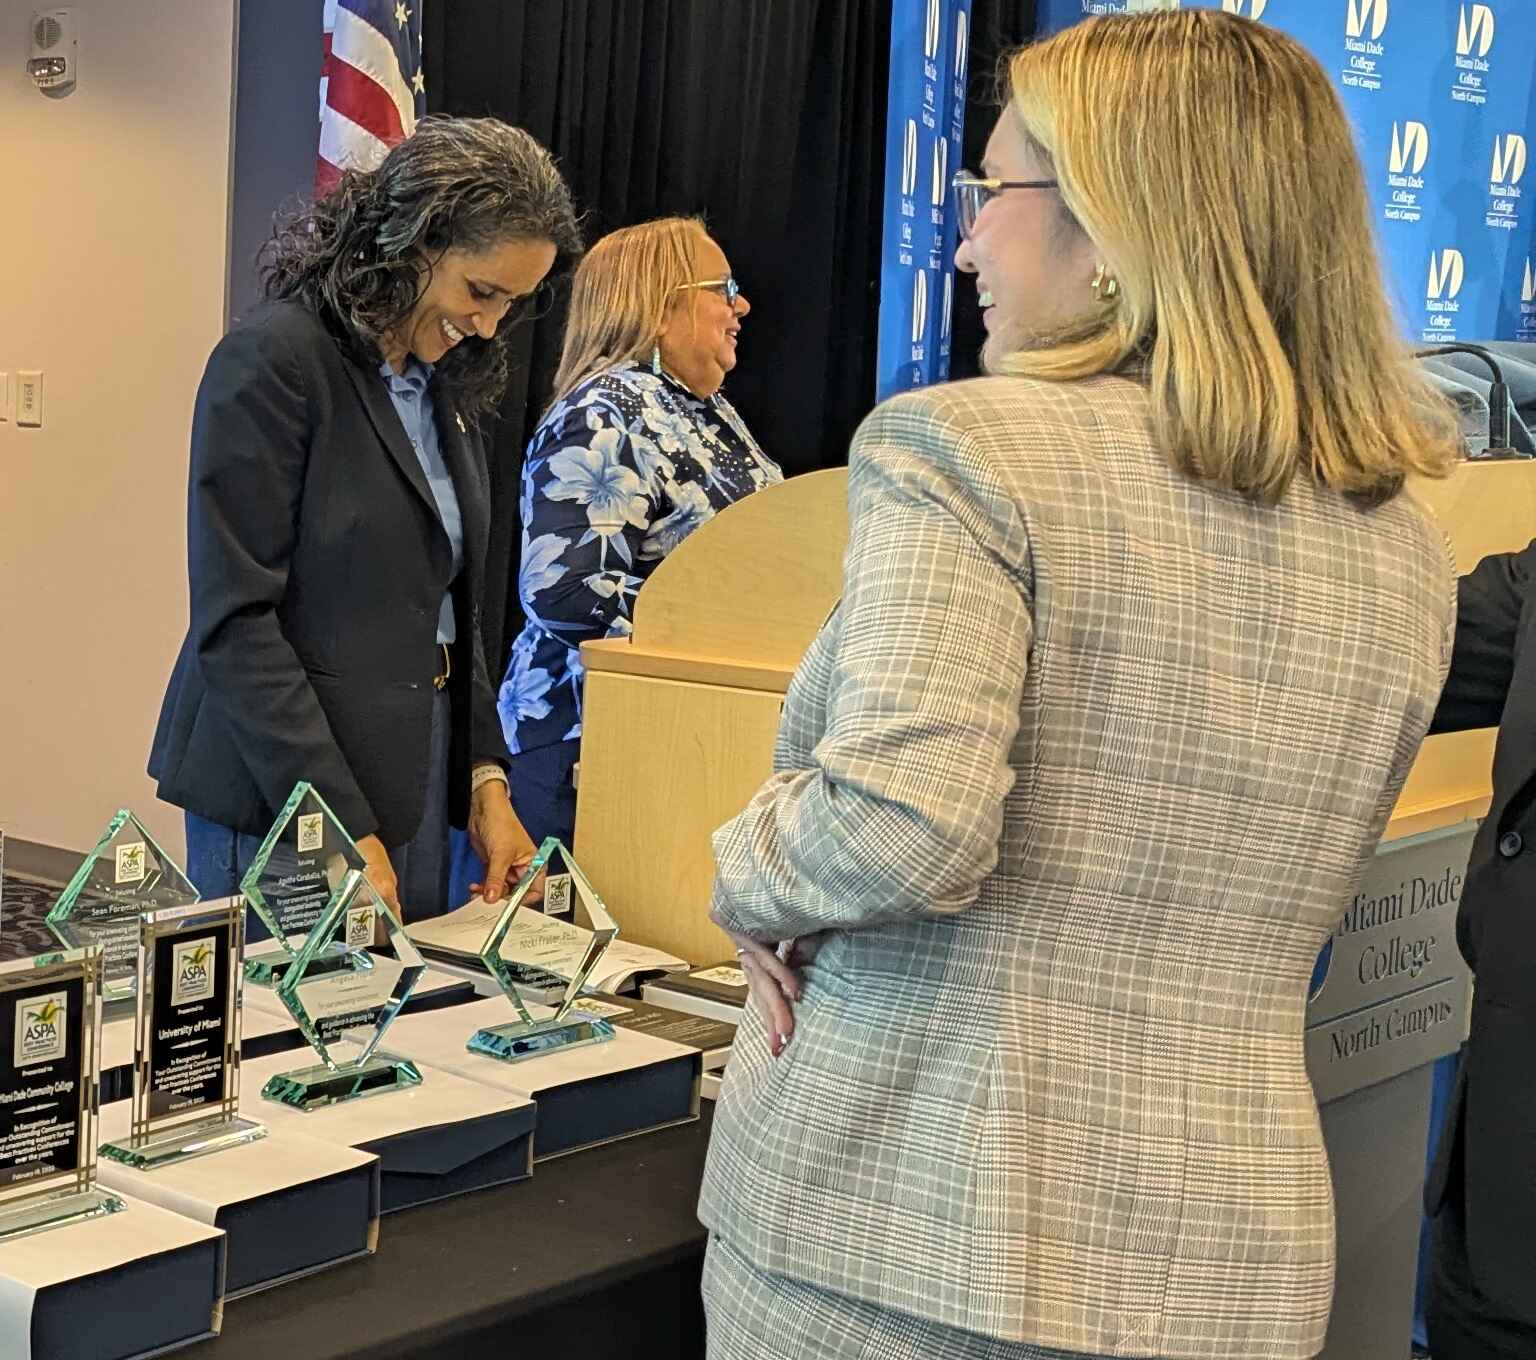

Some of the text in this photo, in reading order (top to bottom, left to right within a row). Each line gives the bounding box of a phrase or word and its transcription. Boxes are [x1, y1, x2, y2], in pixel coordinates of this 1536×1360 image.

[1344, 38, 1384, 56] Miami Dade
[1350, 55, 1376, 73] College
[1455, 55, 1490, 72] Miami Dade
[1342, 75, 1381, 91] North Campus
[1459, 72, 1482, 88] College
[1388, 174, 1424, 189] Miami Dade
[1392, 190, 1416, 205] College
[1410, 866, 1462, 915] Dade
[1358, 935, 1437, 985] College
[181, 966, 206, 980] ASPA
[25, 1024, 56, 1041] ASPA
[159, 1017, 222, 1041] University of Miami
[1329, 998, 1452, 1064] North Campus
[0, 1079, 74, 1104] Miami Dade Community College
